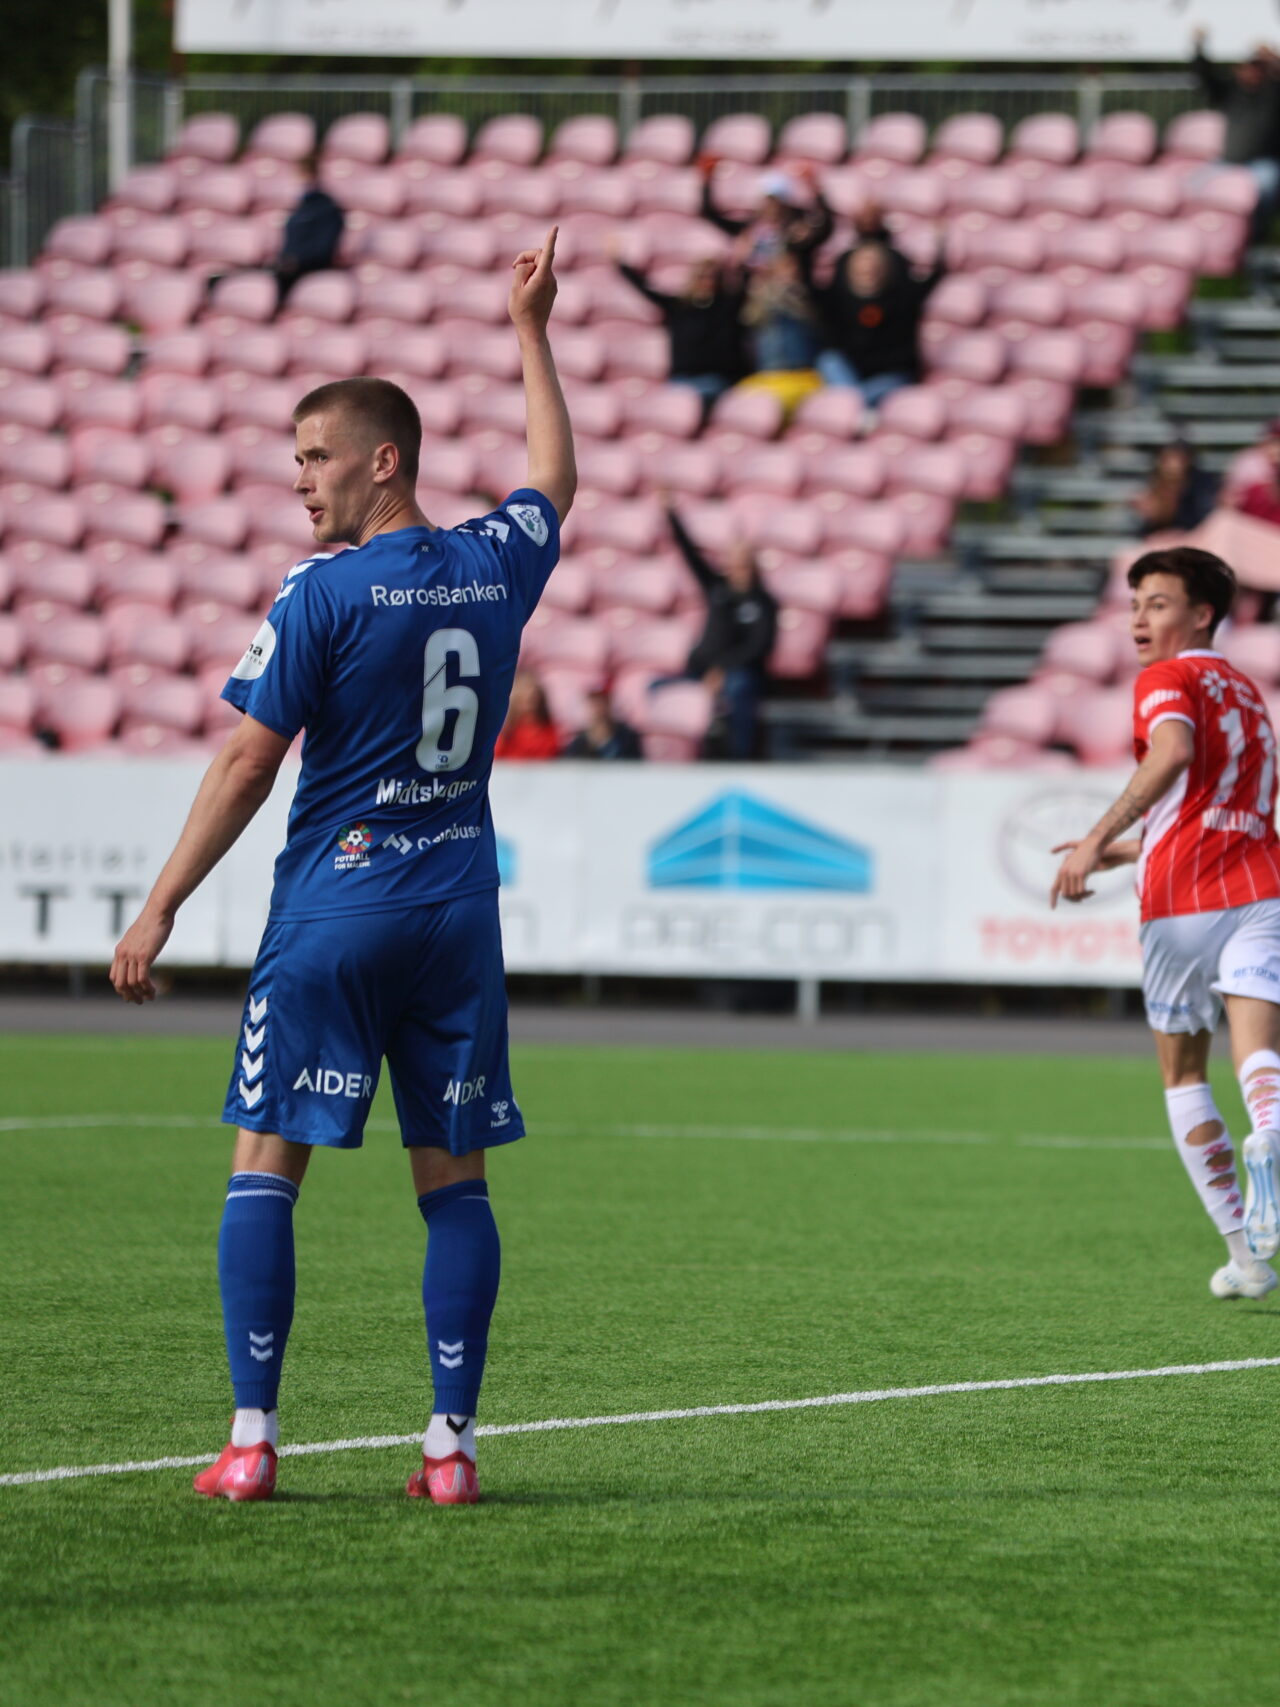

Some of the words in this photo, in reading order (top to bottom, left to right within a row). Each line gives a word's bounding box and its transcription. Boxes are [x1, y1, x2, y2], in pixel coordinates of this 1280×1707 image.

[371, 580, 507, 607] RørosBanken
[415, 627, 480, 773] 6
[980, 919, 1142, 963] TOYOT
[293, 1068, 372, 1099] AIDER
